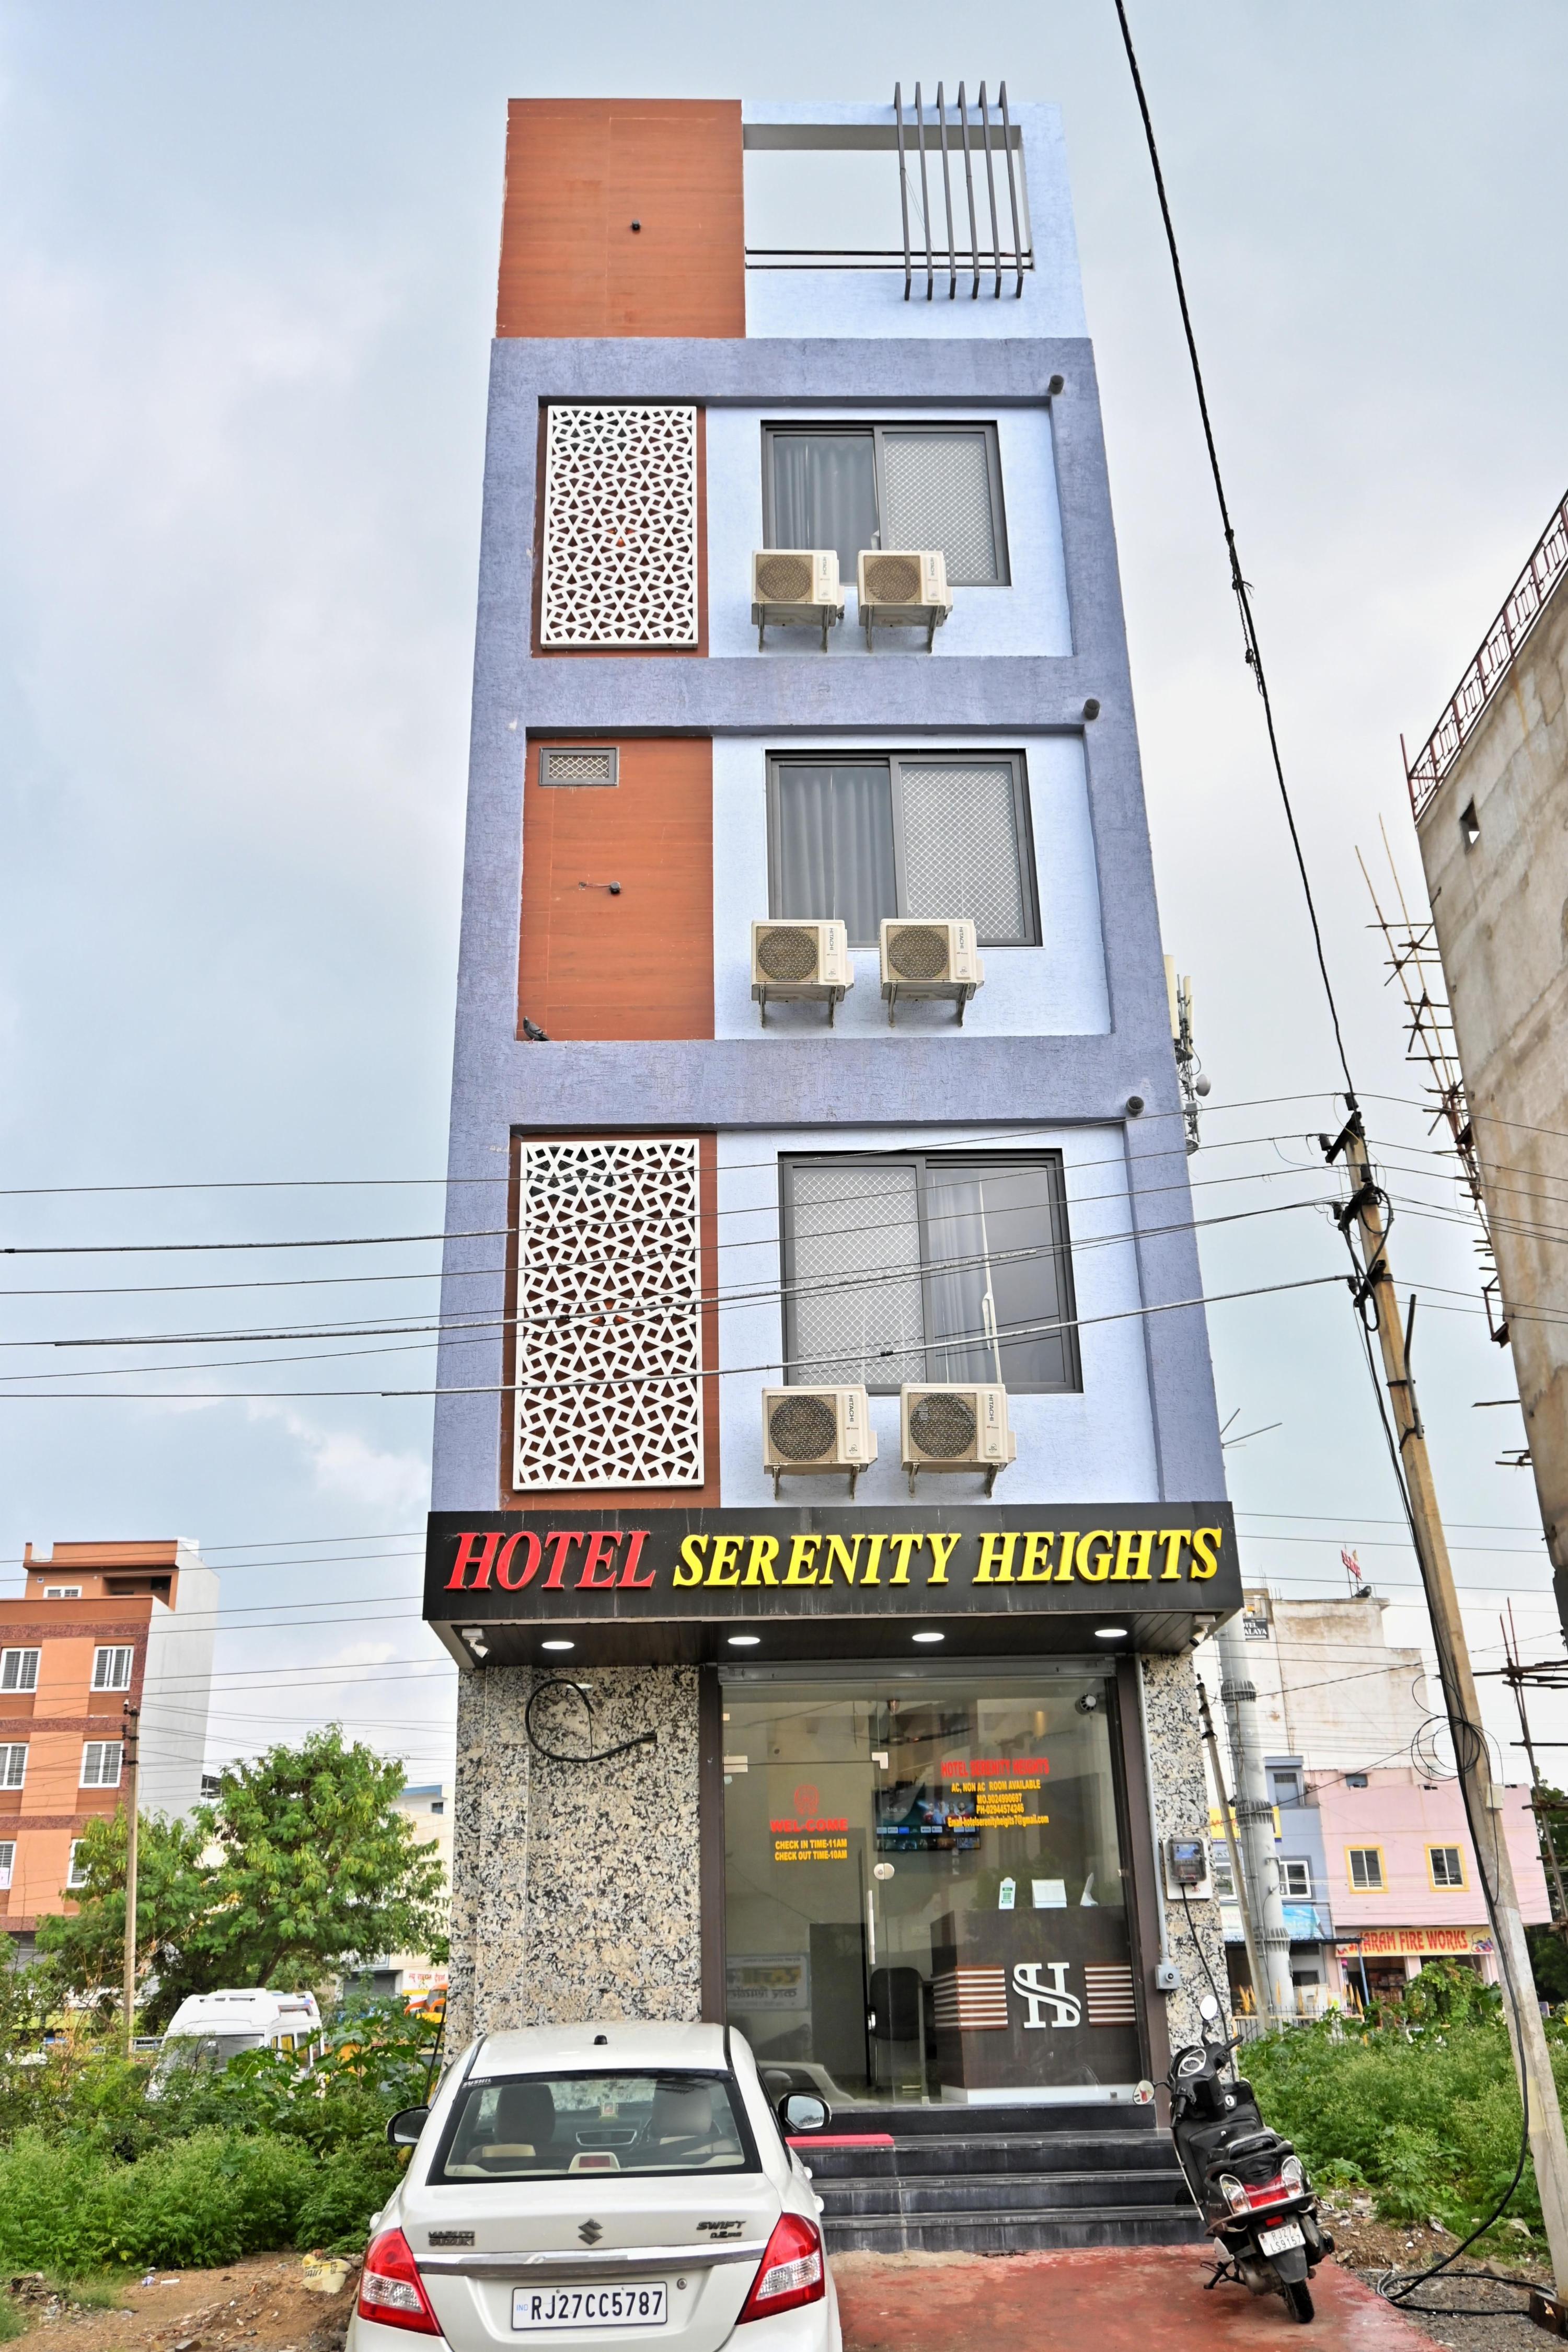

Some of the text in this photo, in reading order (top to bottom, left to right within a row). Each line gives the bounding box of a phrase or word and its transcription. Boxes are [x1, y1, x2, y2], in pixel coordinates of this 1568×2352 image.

[443, 1527, 1221, 1592] HOTEL SERENITY HEIGHTS
[941, 1757, 1049, 1777] HOTEL SERENITY HEIGHTS
[951, 1779, 1041, 1793] AC, NON AC ROOM AVAILABLE
[770, 1818, 848, 1833] WEL-COME
[775, 1838, 847, 1850] CHECK IN TIME-11AM
[775, 1850, 847, 1861] CHECK OUT TIME-10AM
[1399, 1932, 1424, 1952] FIRE
[1425, 1930, 1468, 1951] WORKS
[463, 2078, 491, 2087] SUSHIL
[696, 2221, 746, 2230] SWIFT
[1271, 2227, 1292, 2241] RJ27
[1270, 2234, 1301, 2252] LS9157
[531, 2291, 662, 2320] RJ27CC5787
